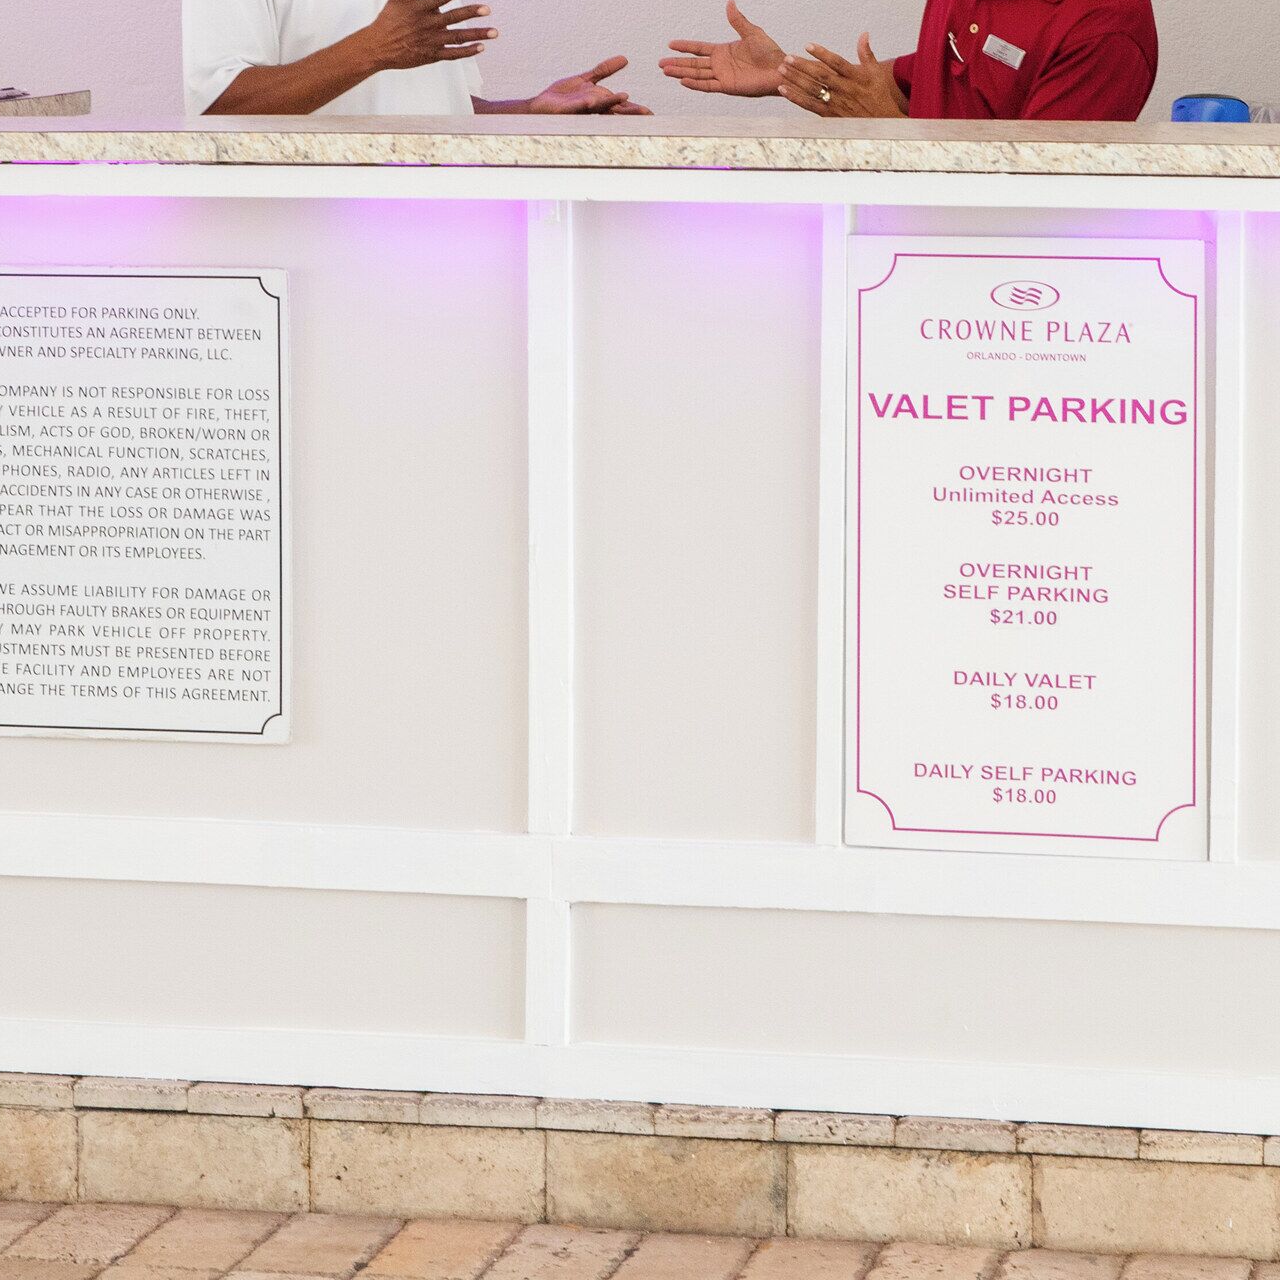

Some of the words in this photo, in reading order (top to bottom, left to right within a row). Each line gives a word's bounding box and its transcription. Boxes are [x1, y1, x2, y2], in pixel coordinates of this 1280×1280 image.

[70, 306, 98, 319] FOR
[101, 306, 159, 320] PARKING
[85, 326, 106, 339] AN
[109, 326, 194, 340] AGREEMENT
[197, 327, 261, 341] BETWEEN
[919, 318, 1033, 342] CROWNE
[1046, 320, 1131, 343] PLAZA
[36, 345, 67, 358] AND
[69, 345, 137, 359] SPECIALTY
[966, 350, 1017, 361] ORLANDO
[1024, 352, 1087, 362] DOWNTOWN
[61, 385, 74, 398] IS
[78, 385, 107, 399] NOT
[111, 386, 201, 400] RESPONSIBLE
[206, 387, 233, 401] FOR
[237, 388, 270, 402] LOSS
[867, 392, 994, 420] VALET
[1008, 395, 1188, 426] PARKING
[12, 444, 103, 458] MECHANICAL
[119, 466, 149, 479] ANY
[151, 466, 215, 481] ARTICLES
[220, 467, 251, 481] LEFT
[256, 468, 270, 481] IN
[958, 465, 1093, 483] OVERNIGHT
[932, 486, 1034, 504] Unlimited
[1040, 489, 1119, 506] Access
[37, 504, 74, 517] THAT
[77, 504, 105, 518] THE
[110, 505, 143, 519] LOSS
[147, 506, 168, 519] OR
[172, 506, 234, 521] DAMAGE
[239, 508, 271, 522] WAS
[991, 509, 1060, 526] $25.00
[24, 523, 44, 537] OR
[47, 524, 180, 539] MISAPPROPRIATION
[183, 526, 205, 540] ON
[208, 527, 234, 541] THE
[238, 528, 271, 542] PART
[78, 544, 98, 558] OR
[101, 545, 121, 558] ITS
[959, 562, 1093, 581] OVERNIGHT
[943, 583, 1000, 600] SELF
[1007, 585, 1109, 604] PARKING
[59, 604, 107, 618] FAULTY
[111, 605, 162, 619] BRAKES
[165, 606, 186, 620] OR
[189, 607, 271, 622] EQUIPMENT
[989, 608, 1057, 625] $21.00
[10, 622, 42, 636] MAY
[49, 623, 86, 637] PARK
[91, 624, 152, 639] VEHICLE
[158, 626, 186, 639] OFF
[15, 662, 75, 676] FACILITY
[79, 664, 112, 678] AND
[117, 665, 202, 680] EMPLOYEES
[207, 667, 234, 681] ARE
[241, 669, 272, 682] NOT
[953, 670, 1017, 687] DAILY
[1023, 672, 1097, 690] VALET
[39, 683, 66, 697] THE
[70, 684, 118, 698] TERMS
[122, 685, 141, 698] OF
[145, 686, 177, 700] THIS
[990, 692, 1058, 710] $18.00
[913, 762, 974, 779] DAILY
[980, 764, 1034, 781] SELF
[1040, 766, 1137, 786] PARKING
[992, 786, 1057, 804] $18.00
